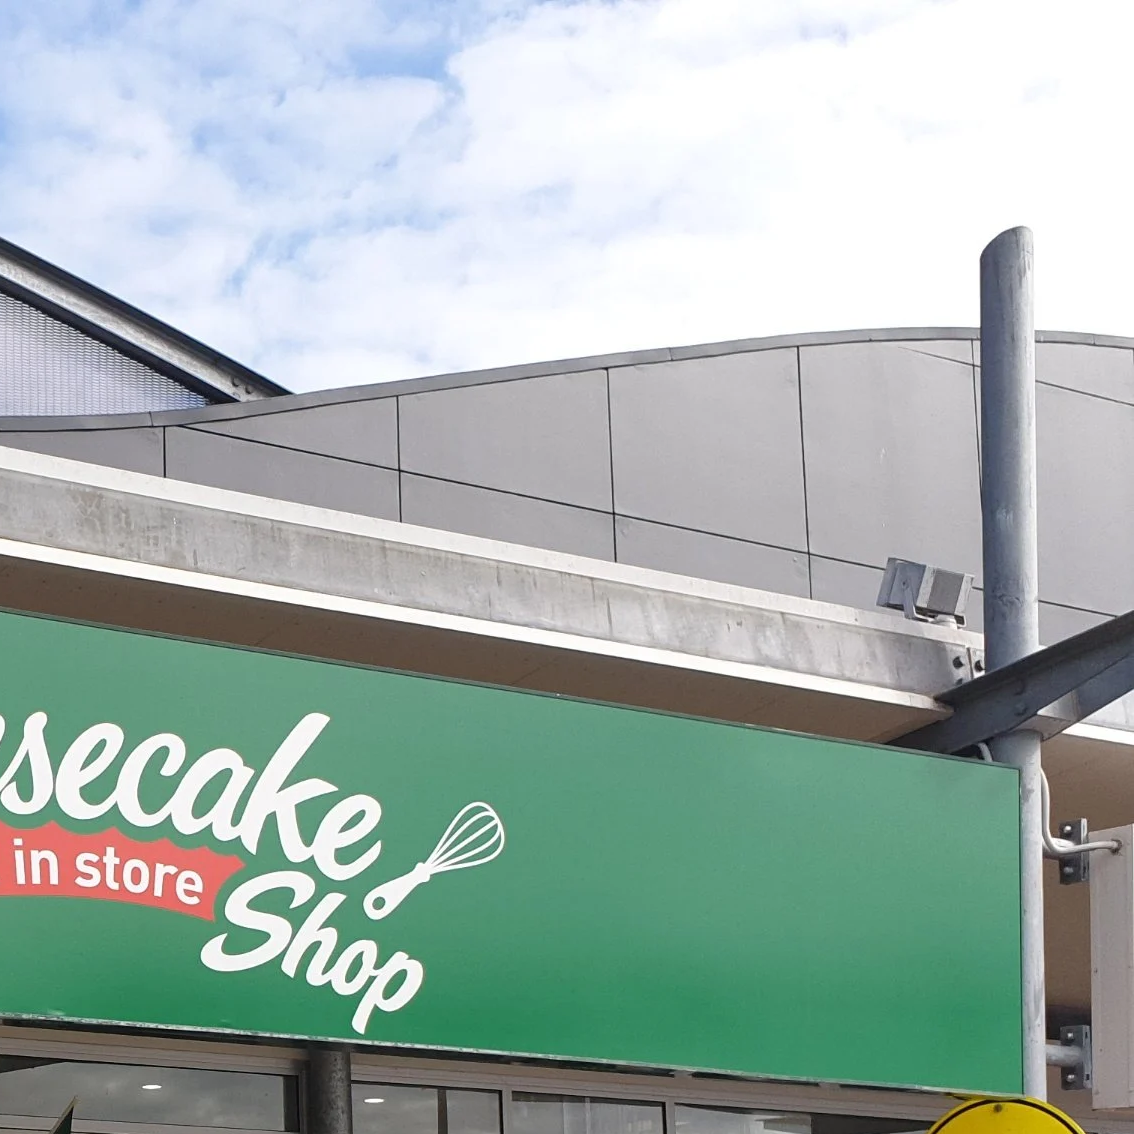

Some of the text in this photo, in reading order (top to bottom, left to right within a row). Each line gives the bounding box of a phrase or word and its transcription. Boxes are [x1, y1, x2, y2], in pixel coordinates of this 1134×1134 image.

[13, 837, 60, 889] in
[74, 844, 205, 908] store
[199, 869, 425, 1034] Shop
